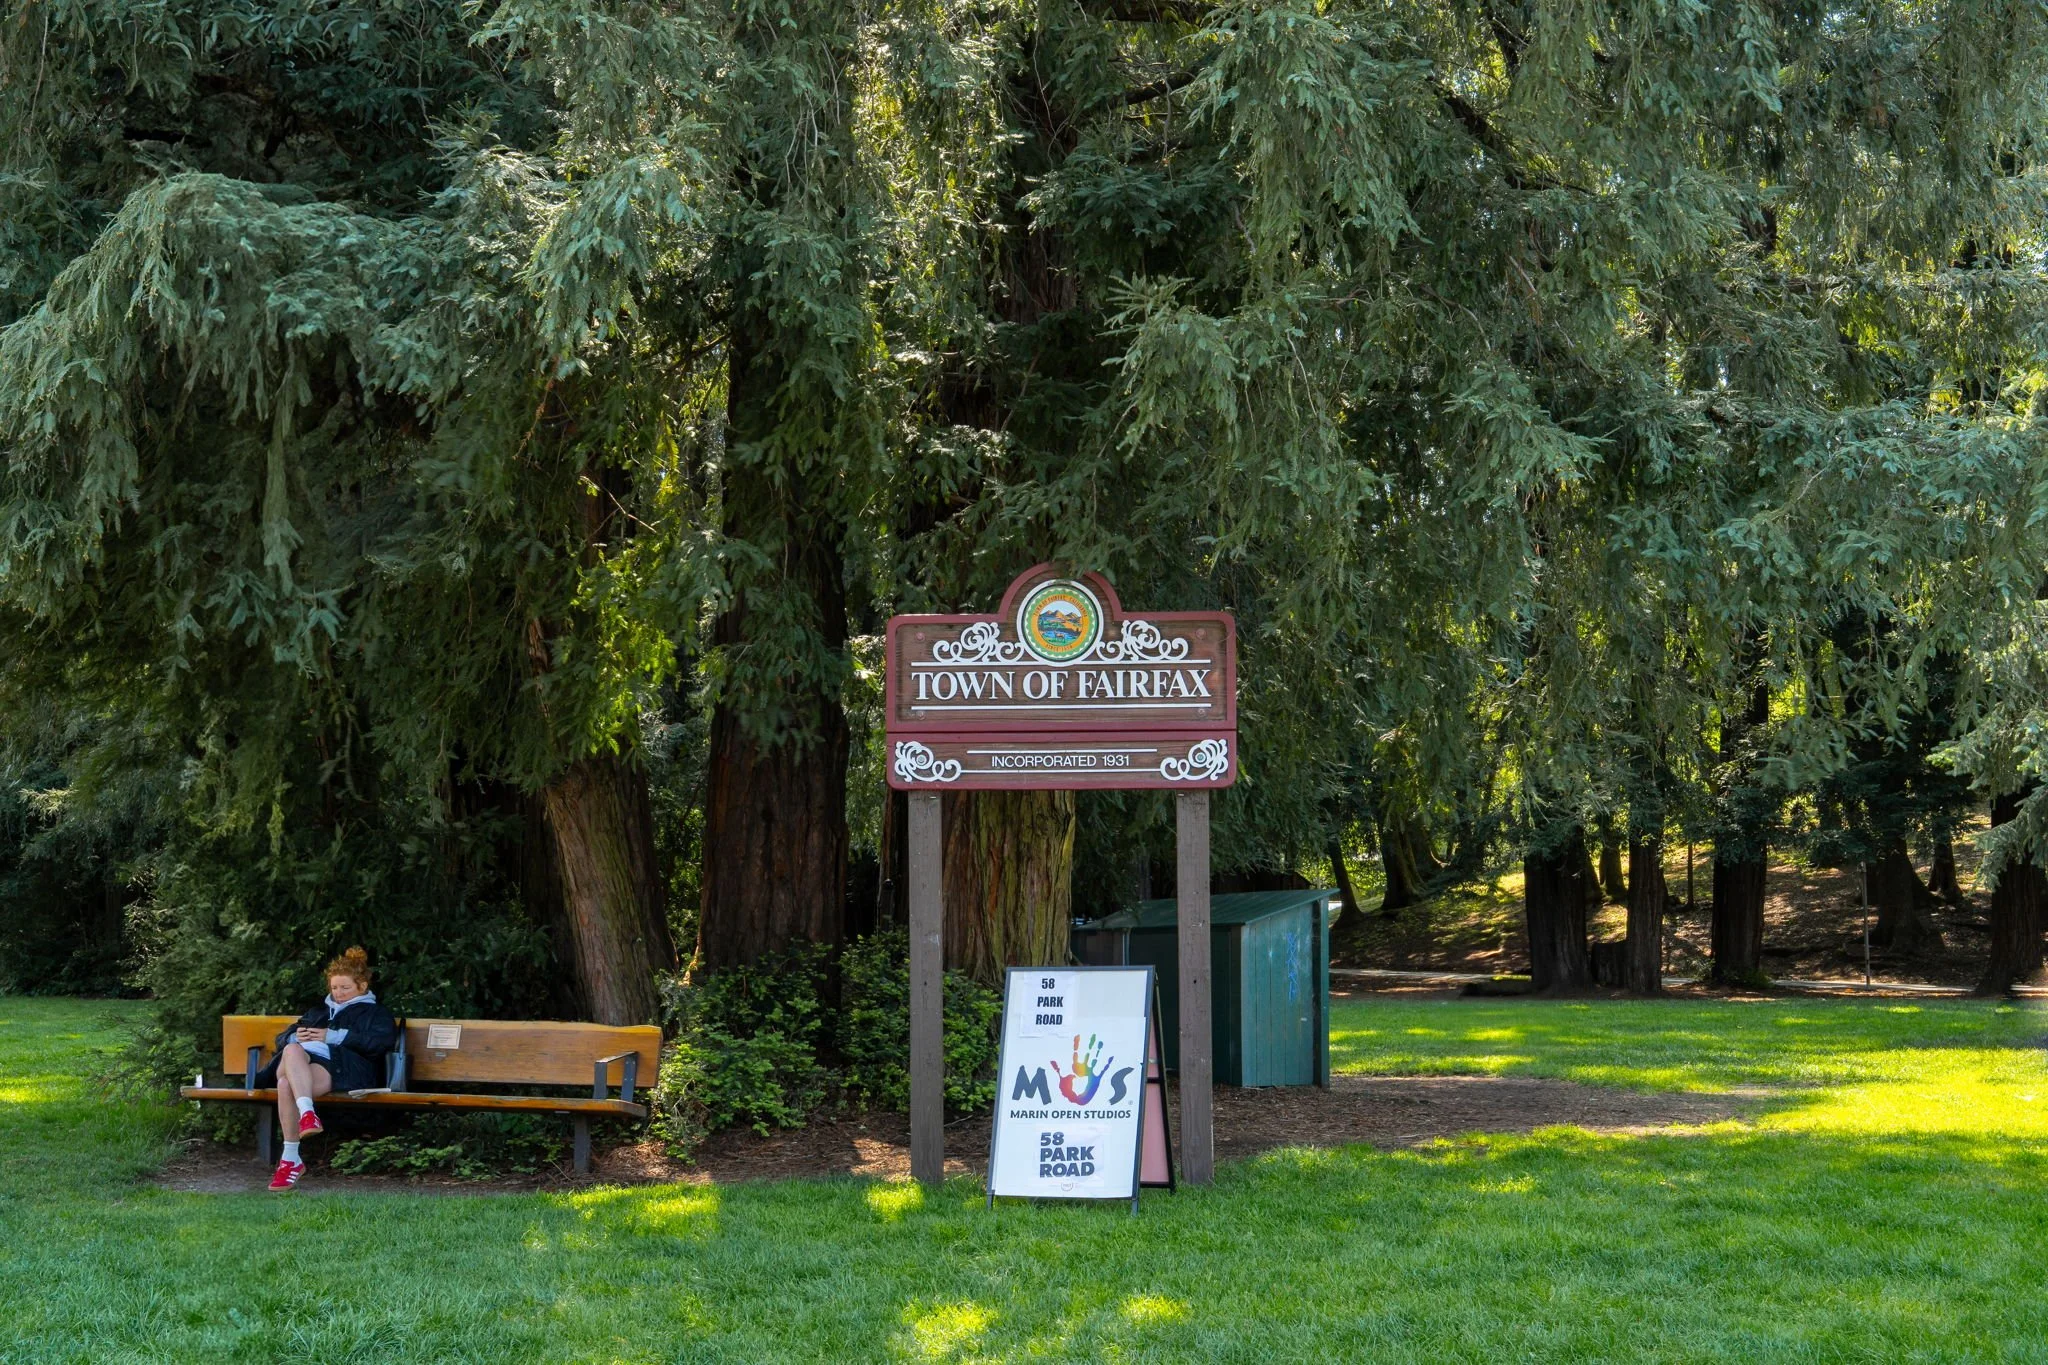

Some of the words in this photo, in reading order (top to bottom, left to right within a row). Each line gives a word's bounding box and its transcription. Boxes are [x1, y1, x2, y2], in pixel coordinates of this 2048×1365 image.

[911, 671, 1016, 700] TOWN
[1022, 670, 1069, 699] OF
[1076, 669, 1212, 699] FAIRFAX
[991, 755, 1097, 767] INCORPORATED
[1102, 754, 1129, 767] 1931
[1041, 978, 1055, 989] 58
[1037, 996, 1064, 1007] PARK
[1035, 1014, 1063, 1025] ROAD
[1010, 1110, 1049, 1119] MARIN
[1051, 1110, 1081, 1119] OPEN
[1084, 1109, 1131, 1119] STUDIOS
[1040, 1131, 1065, 1147] 58
[1040, 1146, 1095, 1162] PARK
[1040, 1162, 1095, 1178] ROAD
